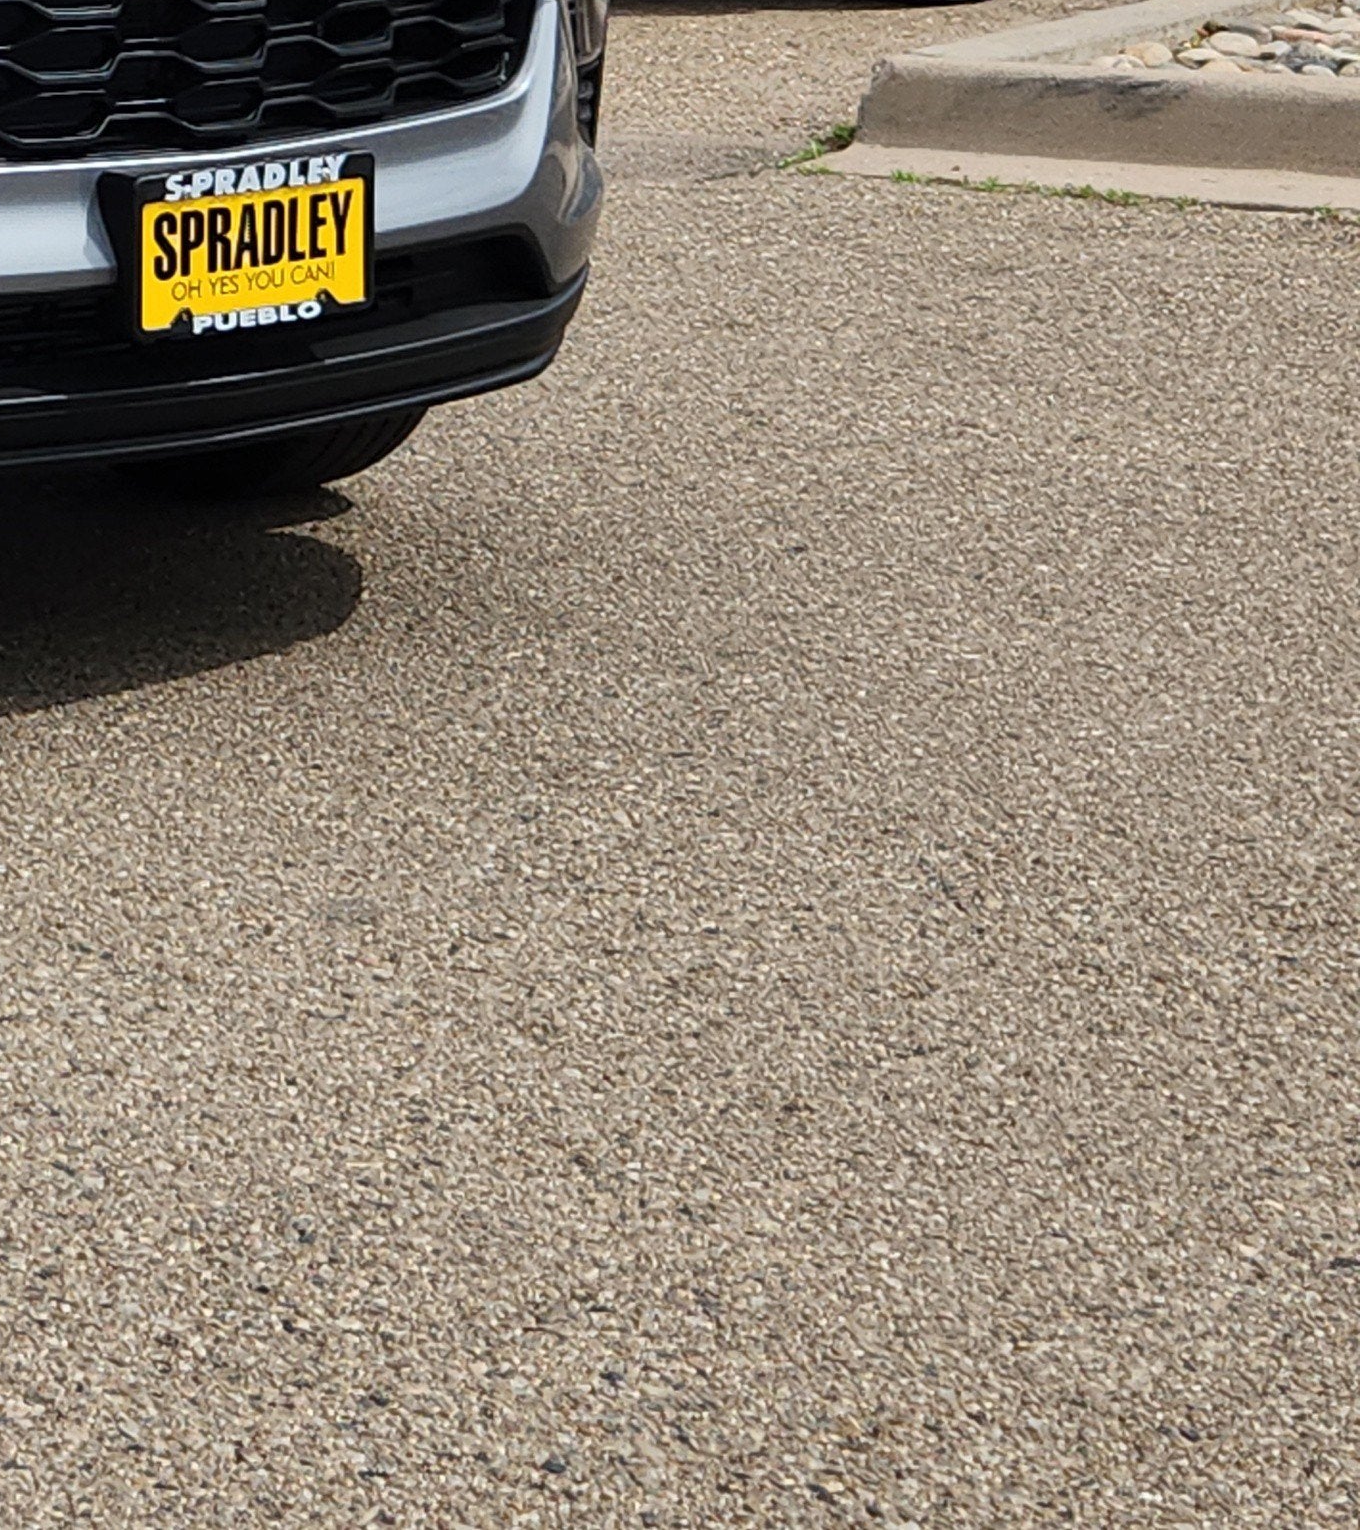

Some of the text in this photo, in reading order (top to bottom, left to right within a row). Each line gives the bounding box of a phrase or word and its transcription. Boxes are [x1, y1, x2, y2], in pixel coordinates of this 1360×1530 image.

[164, 155, 346, 201] SPRADLEY
[153, 188, 355, 281] SPRADLEY
[171, 261, 336, 302] OH YES YOU CAN!
[192, 300, 322, 335] PUEBLO
